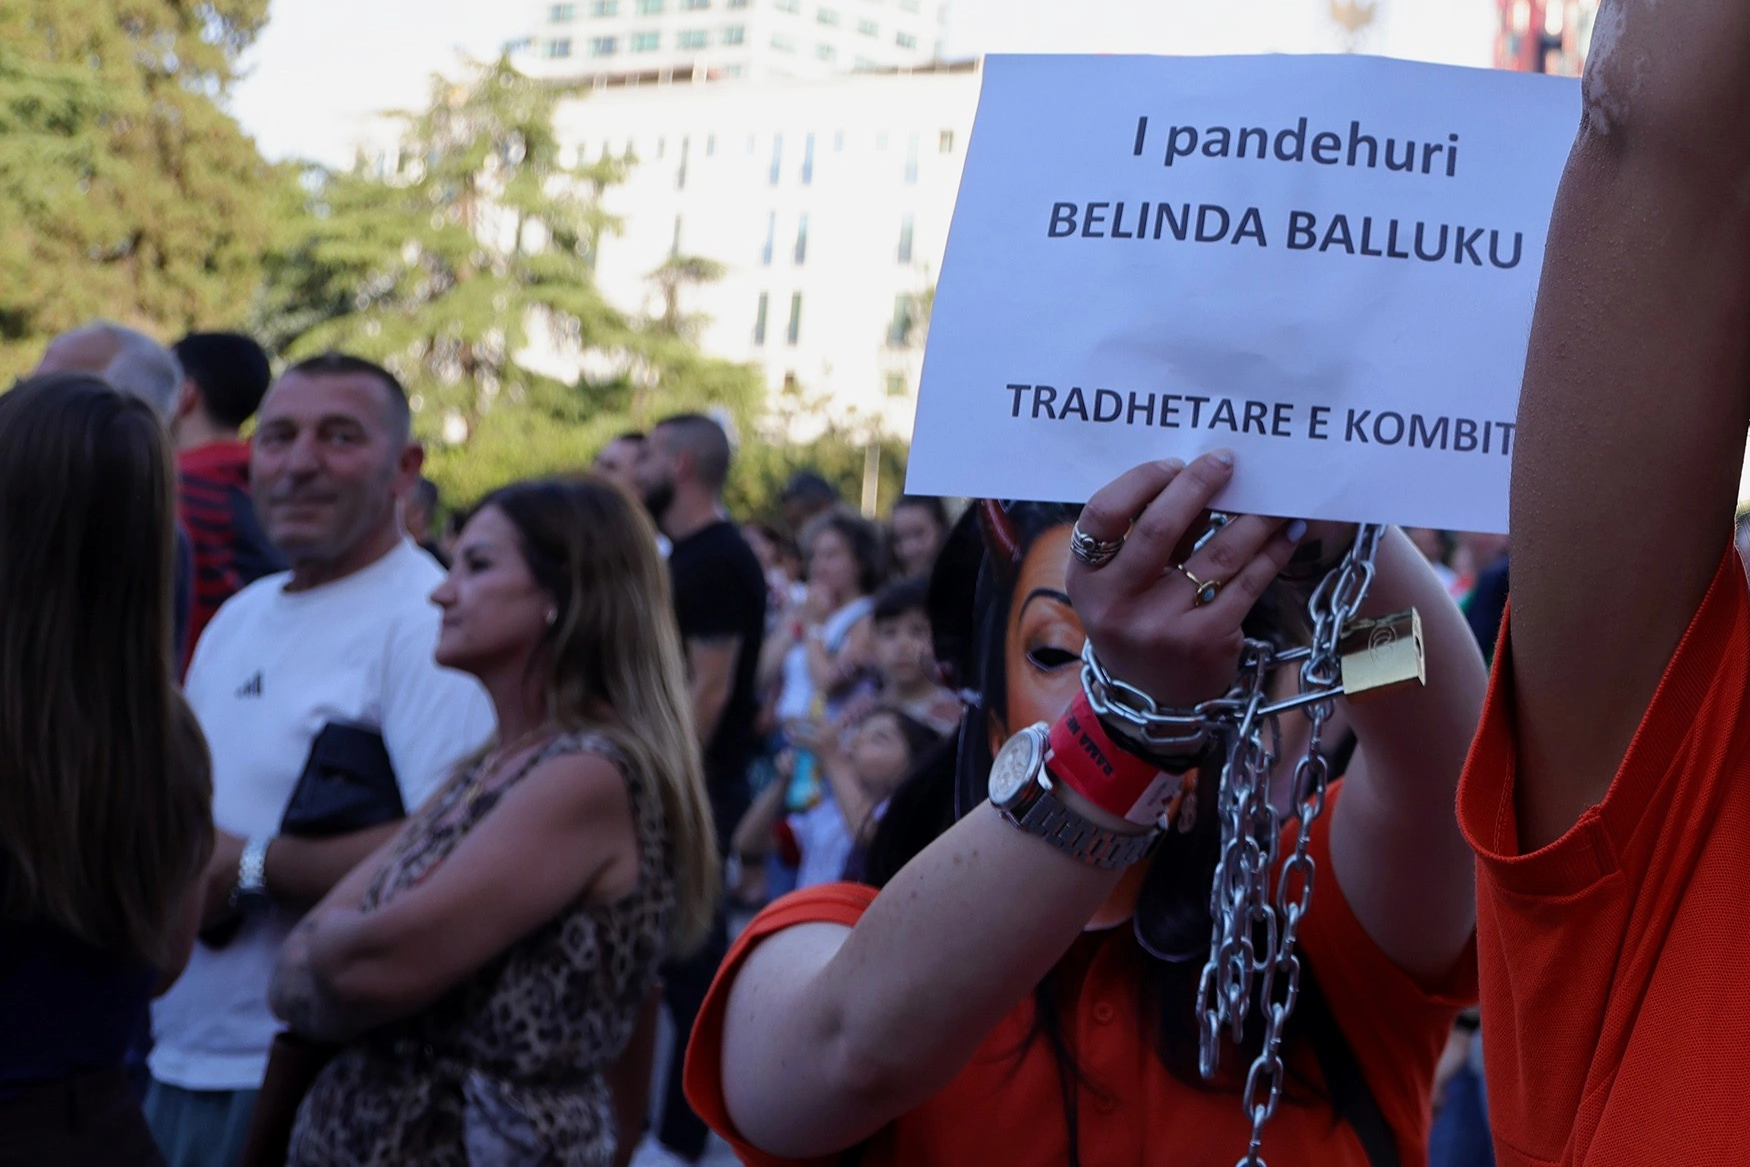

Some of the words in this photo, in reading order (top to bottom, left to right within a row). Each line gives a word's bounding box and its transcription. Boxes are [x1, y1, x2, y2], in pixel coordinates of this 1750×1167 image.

[1131, 115, 1149, 157] I
[1163, 116, 1460, 178] pandehuri
[1046, 200, 1269, 248] BELINDA
[1286, 209, 1524, 270] BALLUKU
[1005, 382, 1295, 438] TRADHETARE
[1307, 405, 1332, 441] E
[1343, 407, 1516, 456] KOMBIT
[1080, 734, 1114, 776] RAMA
